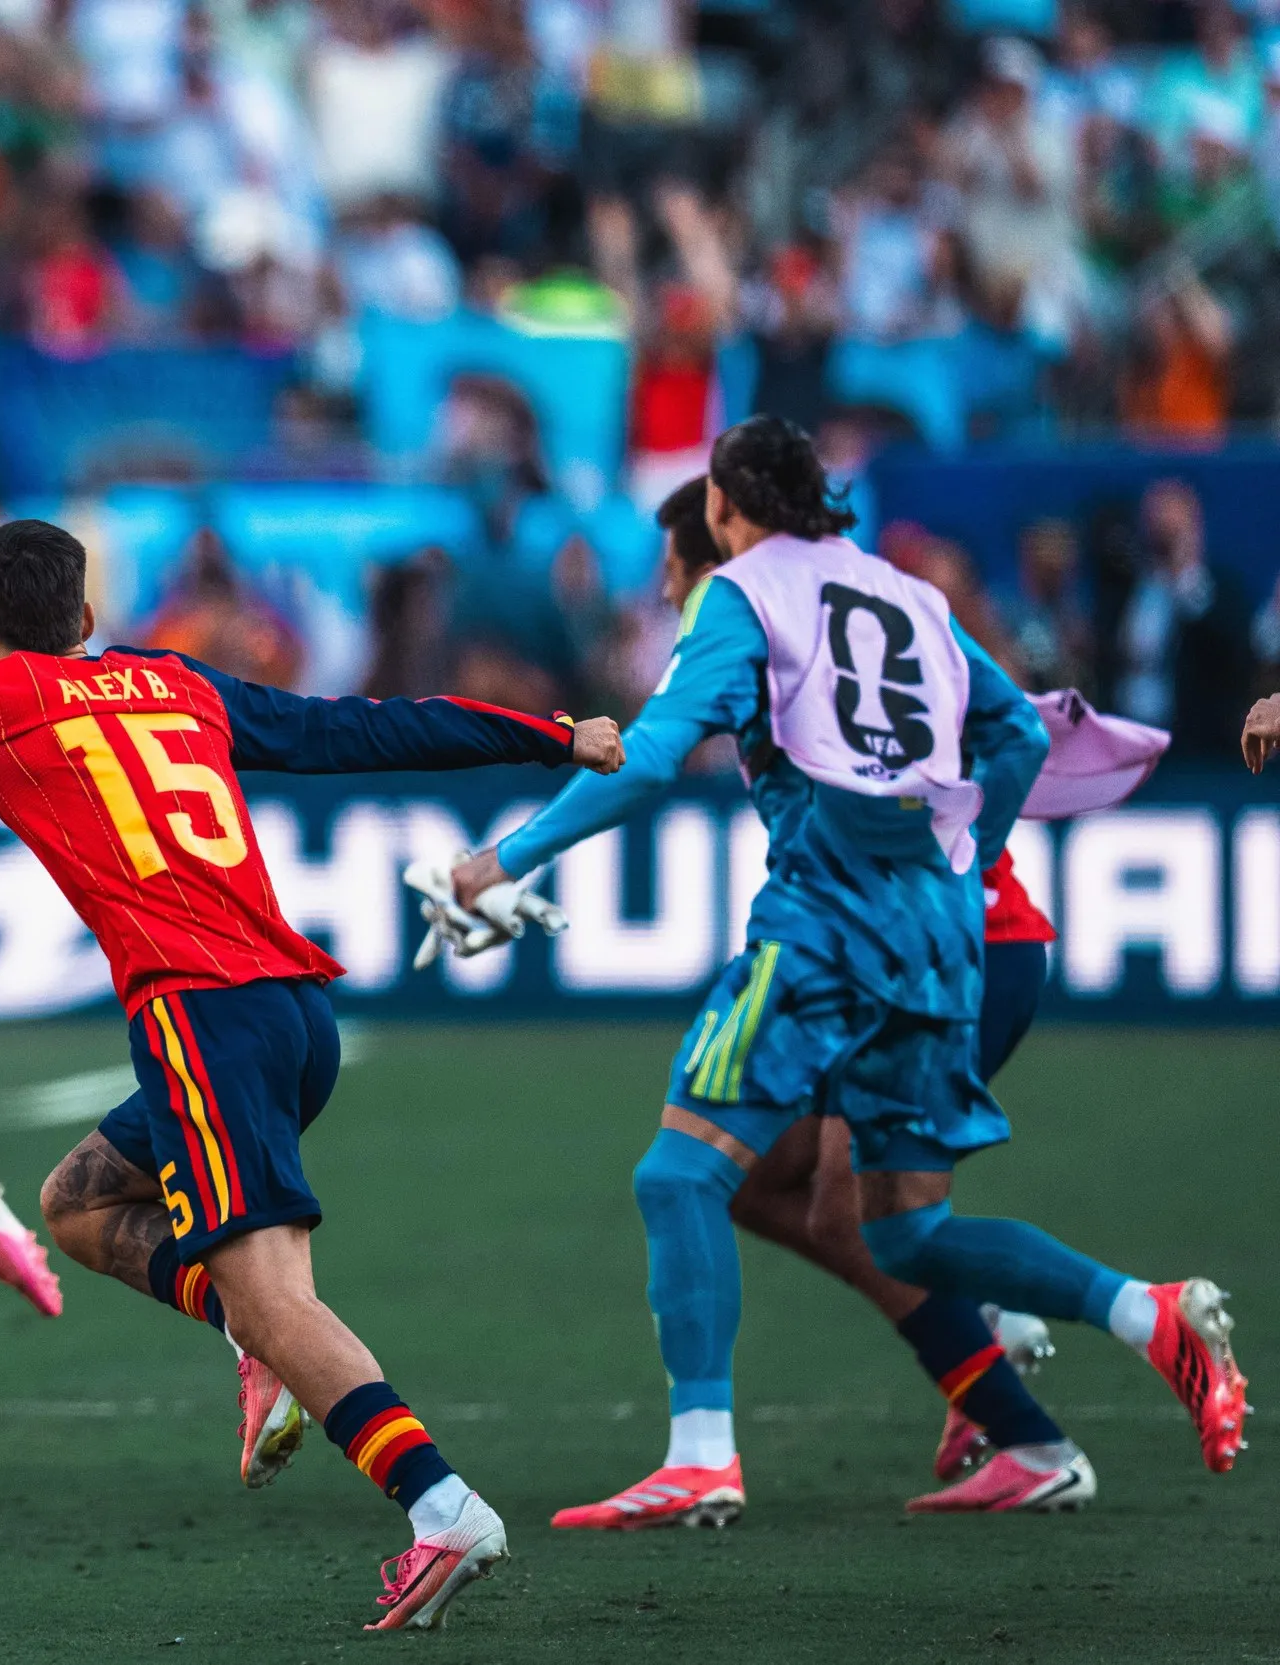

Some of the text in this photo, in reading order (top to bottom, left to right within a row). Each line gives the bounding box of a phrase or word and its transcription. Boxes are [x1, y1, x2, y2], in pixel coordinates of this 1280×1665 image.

[56, 667, 177, 704] ALEX B.
[52, 712, 248, 880] 15
